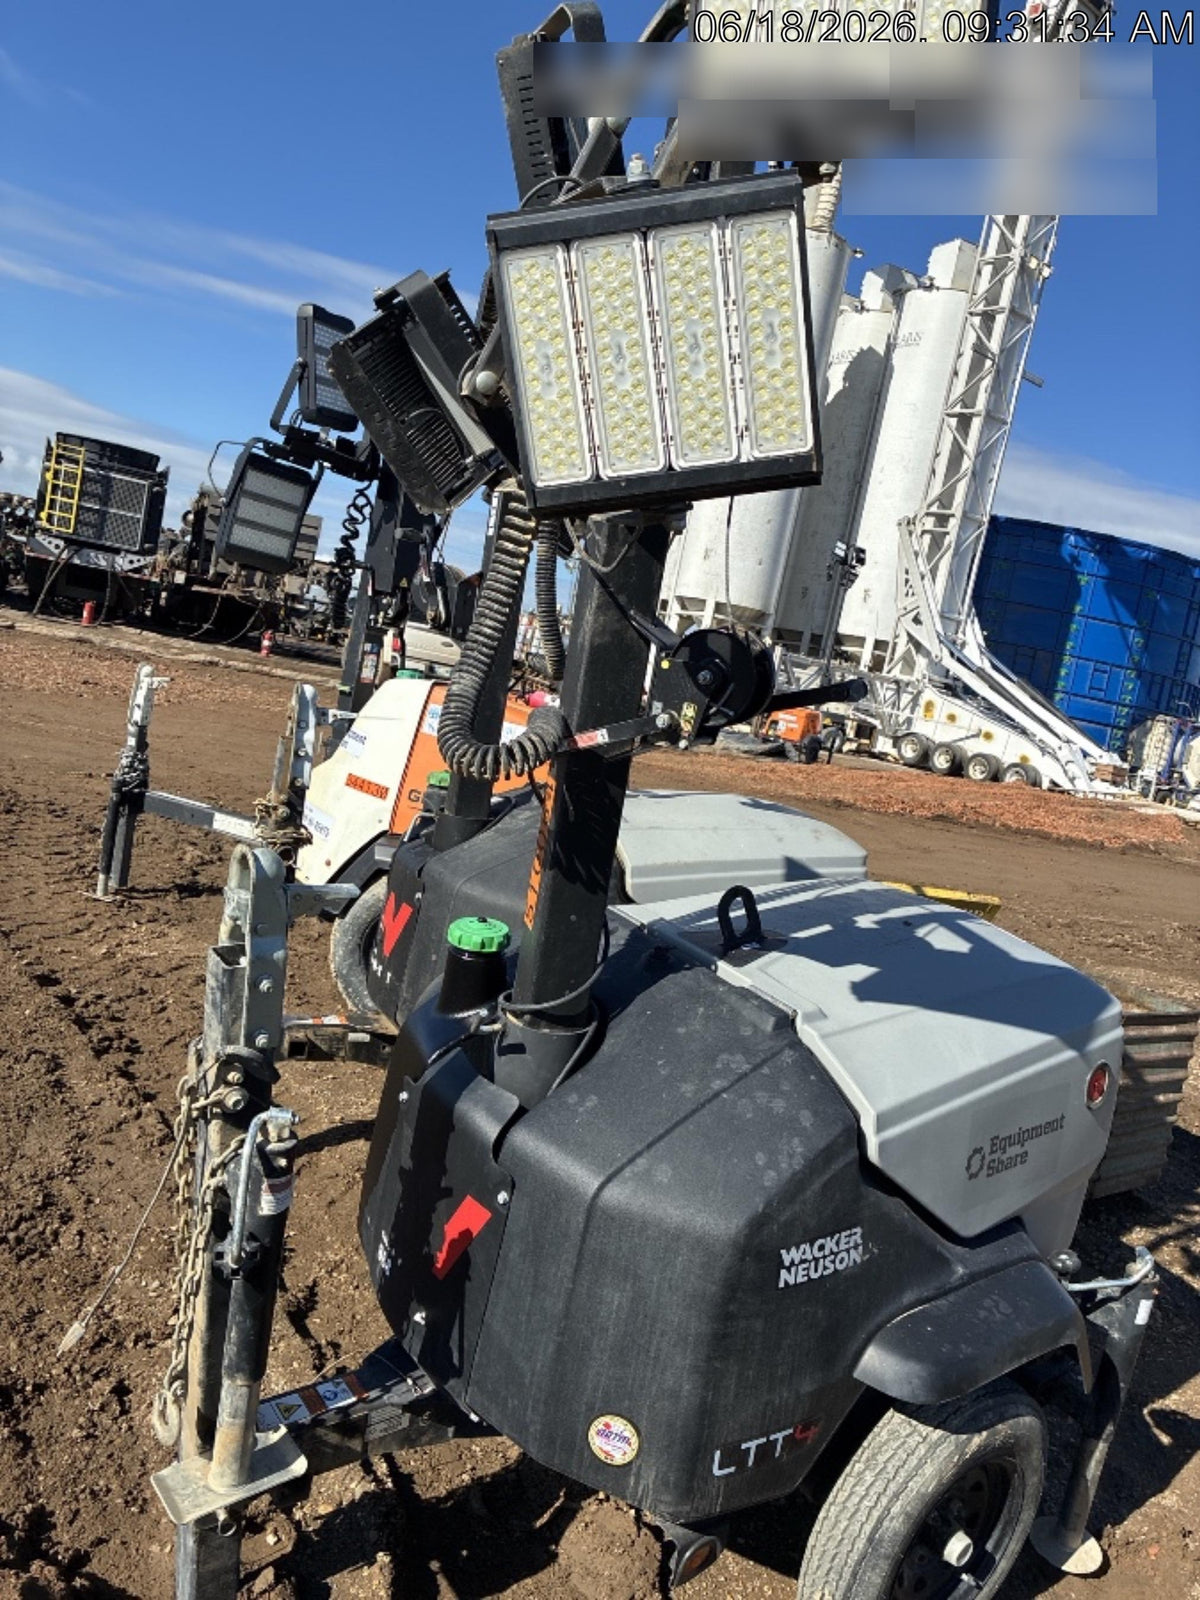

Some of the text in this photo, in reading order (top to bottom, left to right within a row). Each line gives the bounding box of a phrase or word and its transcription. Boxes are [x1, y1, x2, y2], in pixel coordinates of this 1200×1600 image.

[988, 1112, 1066, 1156] Equipment
[986, 1150, 1029, 1178] Share
[778, 1245, 863, 1288] NEUSON
[780, 1226, 863, 1267] WACKER
